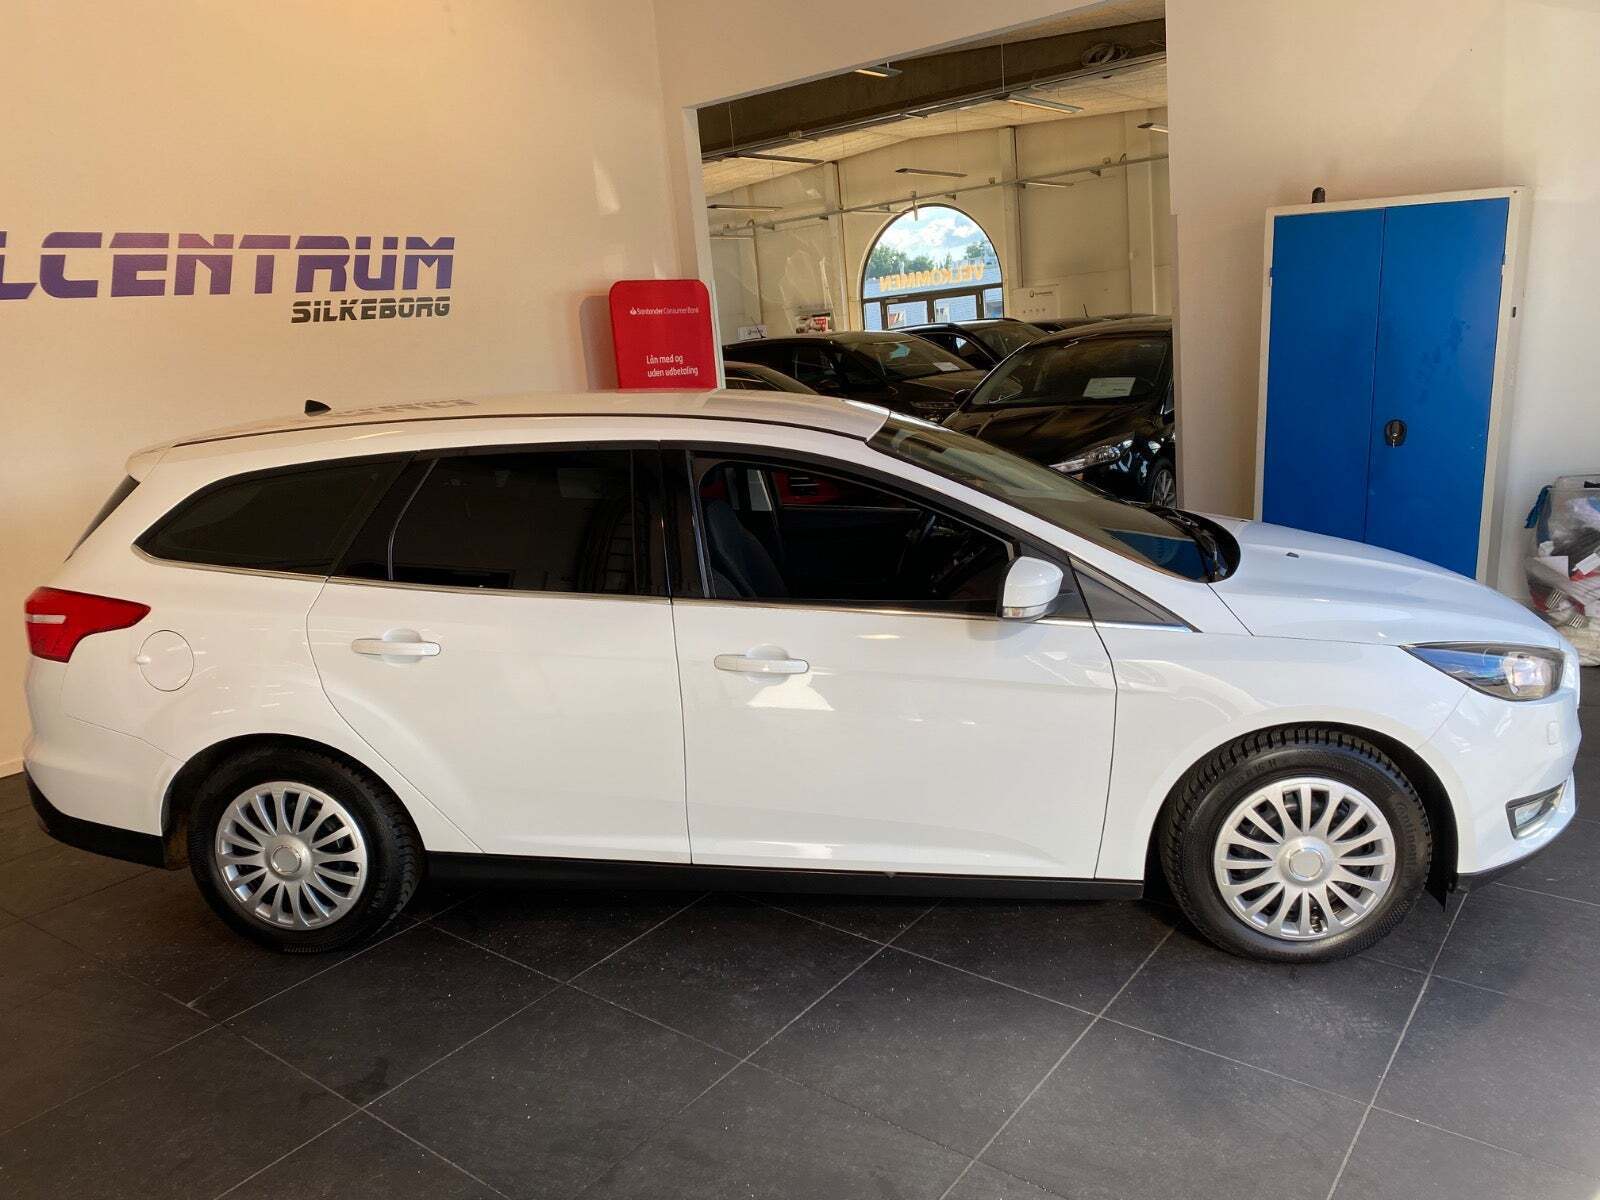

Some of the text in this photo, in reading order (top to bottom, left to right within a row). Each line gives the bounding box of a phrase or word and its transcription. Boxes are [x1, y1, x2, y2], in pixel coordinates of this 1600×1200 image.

[291, 296, 450, 323] SILKEBORG
[636, 306, 699, 315] Santander Consumer Bank
[646, 354, 684, 364] Lån med og
[647, 366, 699, 378] uden udbetaling
